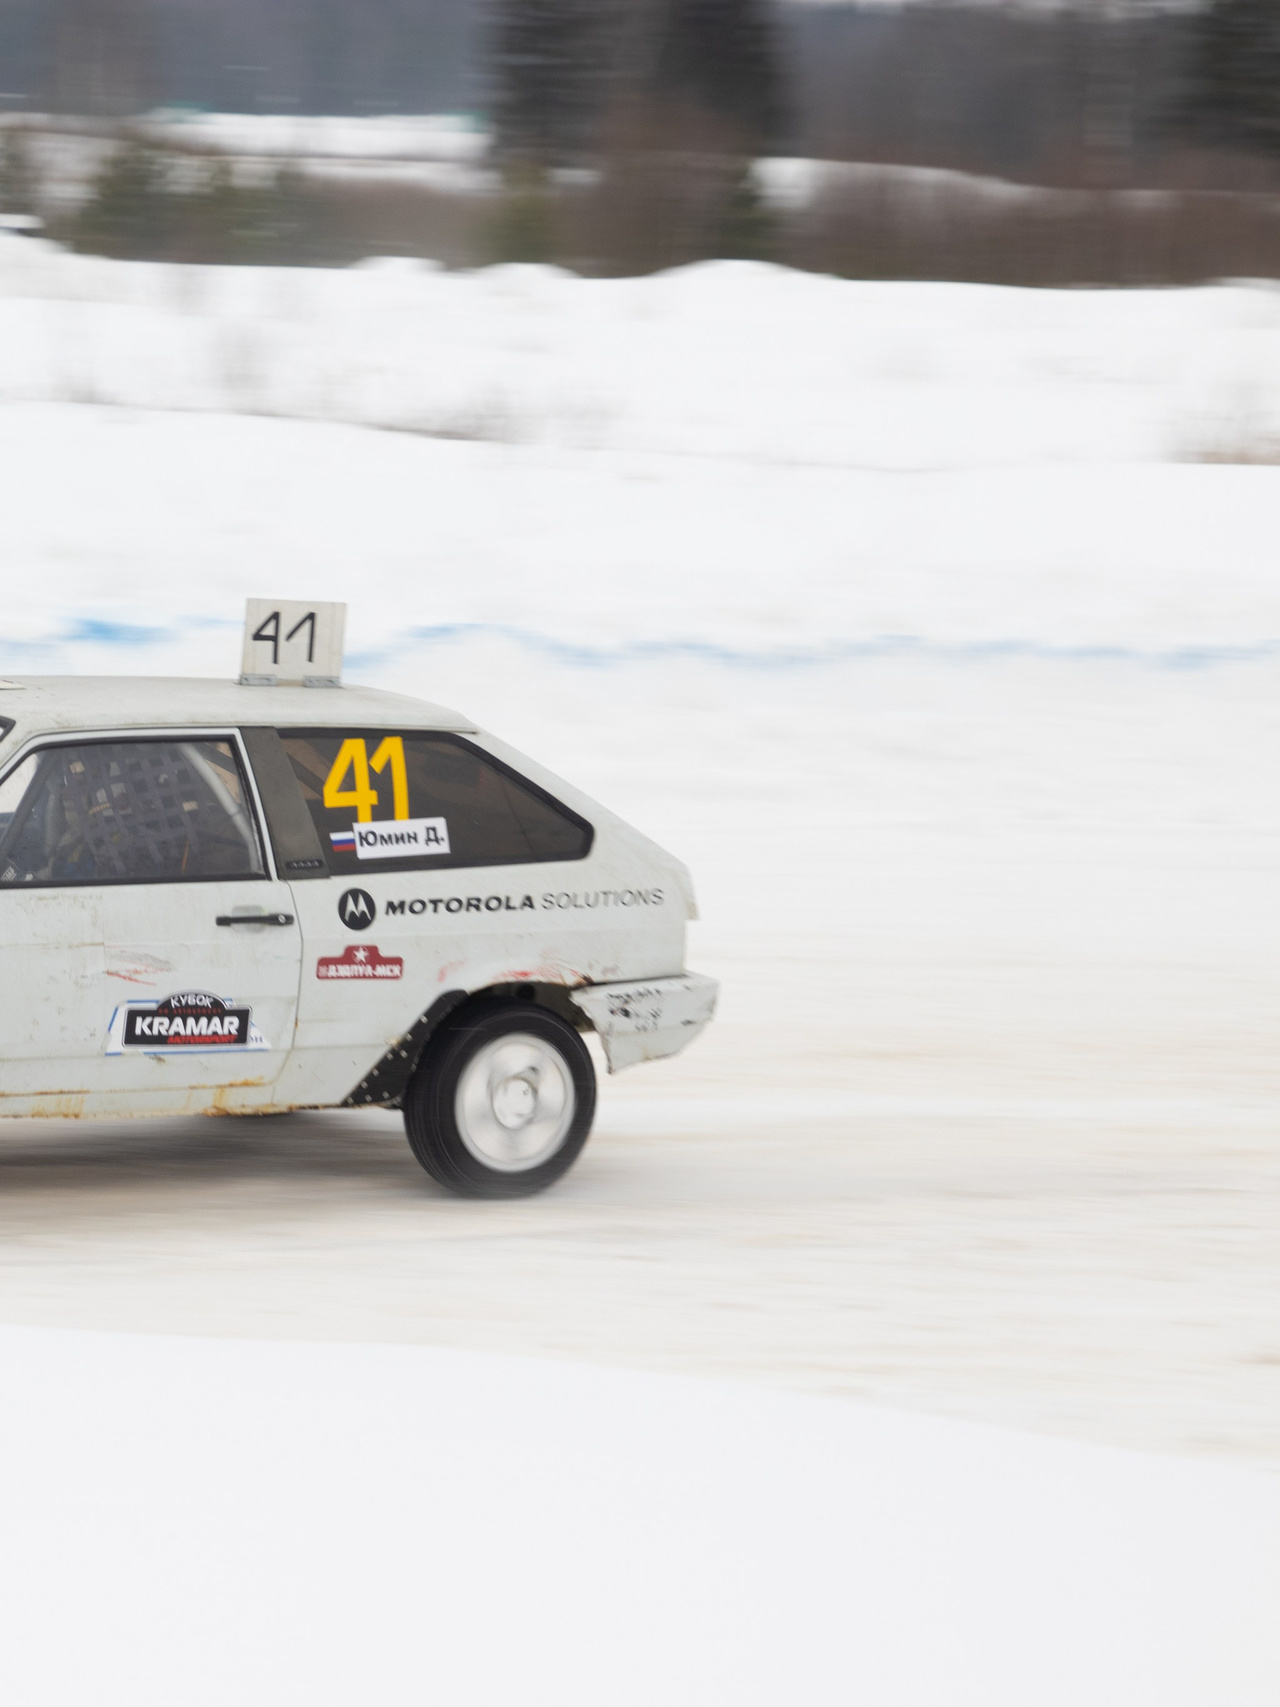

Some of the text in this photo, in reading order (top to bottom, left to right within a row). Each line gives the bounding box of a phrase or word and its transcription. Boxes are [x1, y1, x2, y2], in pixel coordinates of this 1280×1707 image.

[251, 611, 317, 665] 41
[322, 736, 410, 824] 41
[357, 826, 445, 848] Юмин Д.
[385, 895, 536, 916] MOTOROLA
[540, 888, 666, 910] SOLUTIONS
[134, 1015, 240, 1036] KRAMAR
